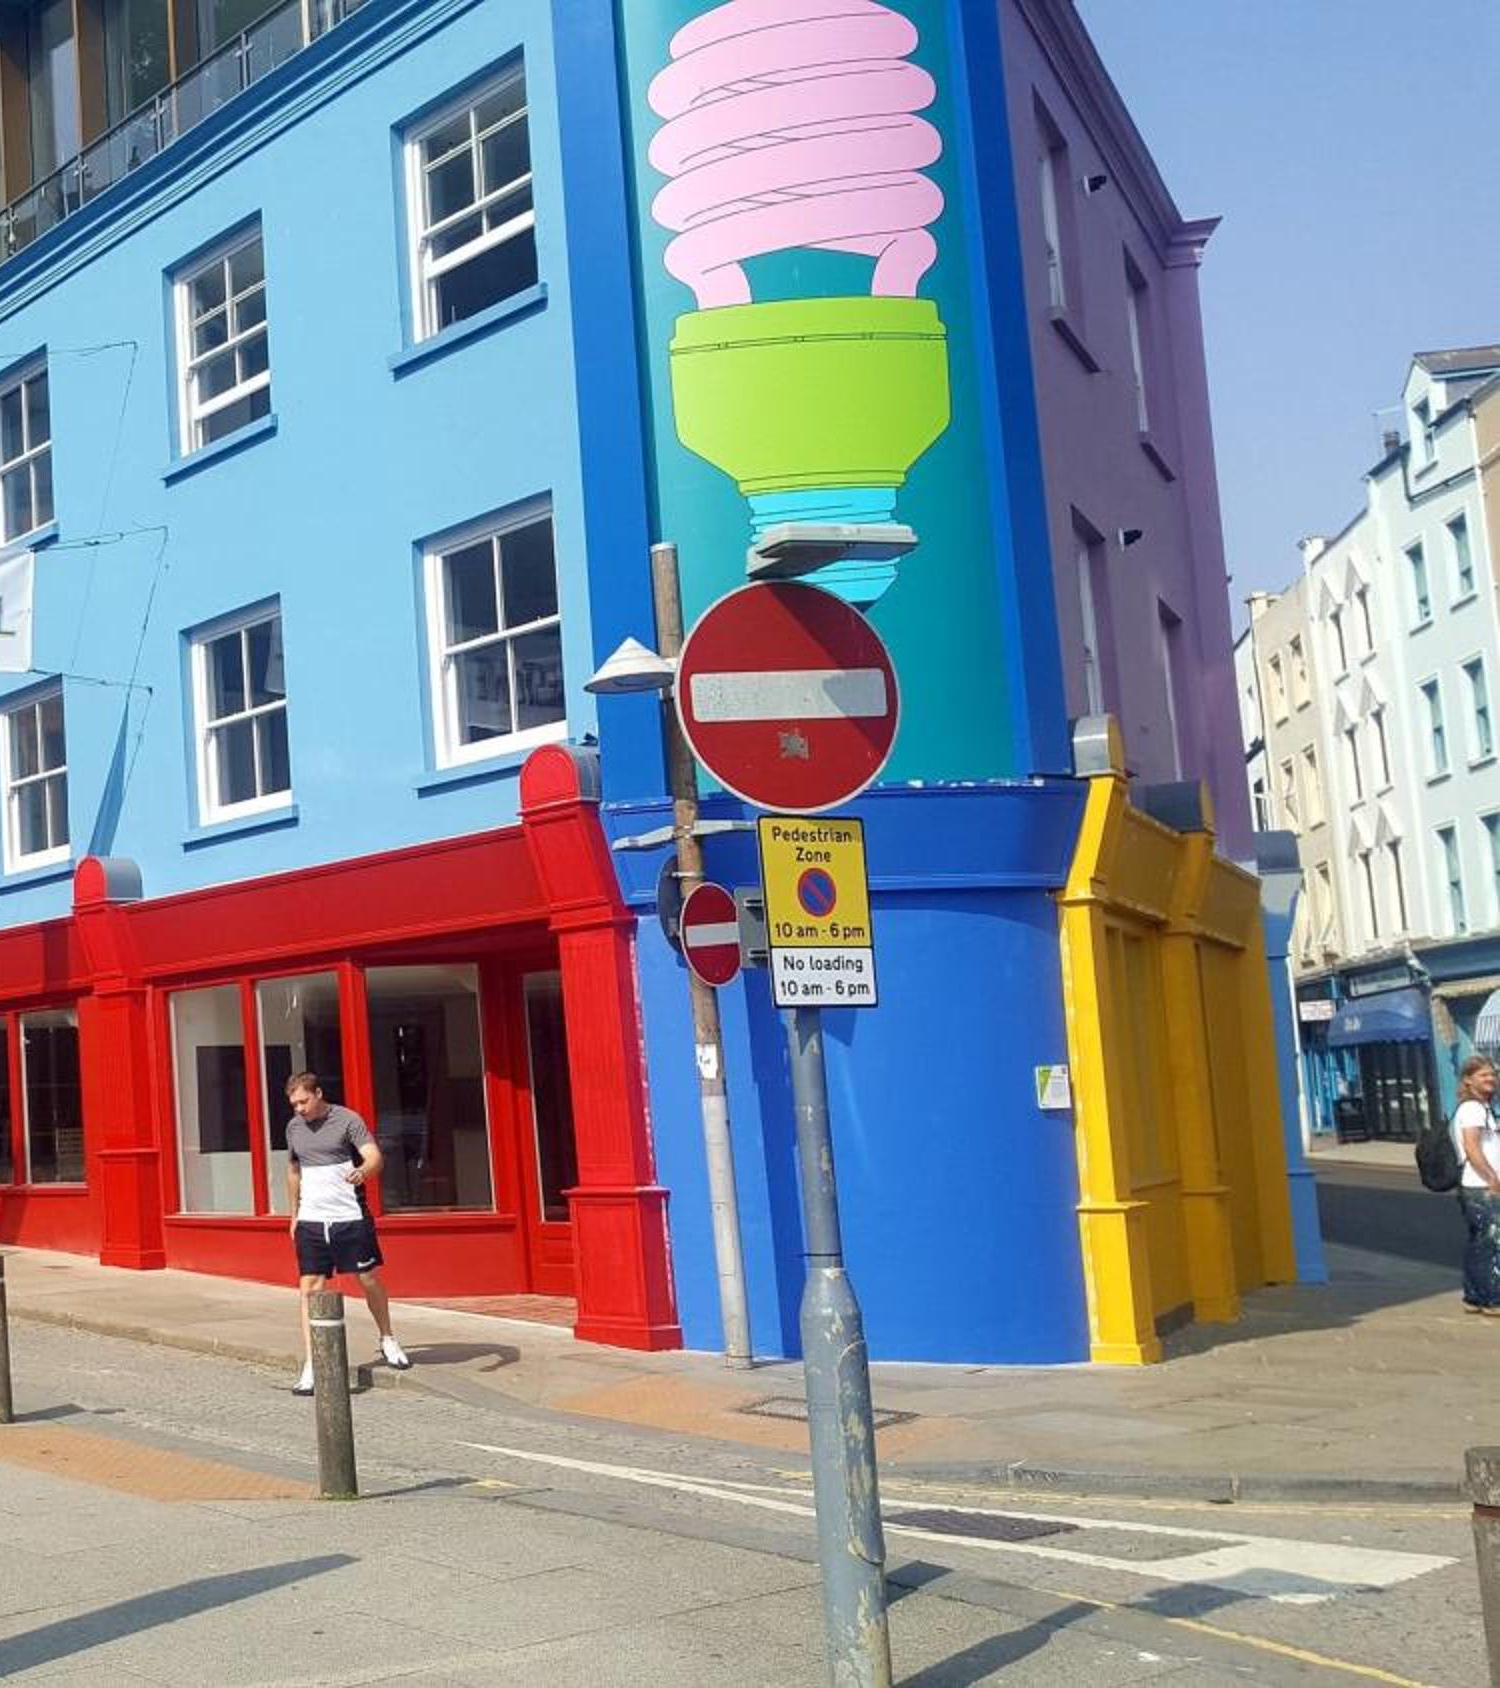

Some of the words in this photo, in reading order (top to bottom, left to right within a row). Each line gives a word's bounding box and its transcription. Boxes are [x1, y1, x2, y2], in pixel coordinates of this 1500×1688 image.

[772, 825, 852, 843] Pedestrian
[795, 847, 831, 862] Zone
[775, 922, 793, 938] 10
[796, 926, 818, 938] am
[830, 922, 839, 938] 6
[843, 926, 865, 940] pm
[783, 955, 805, 970] No
[810, 955, 863, 973] loading
[781, 980, 798, 996] 10
[801, 983, 822, 996] am
[835, 980, 845, 996] 6
[847, 983, 870, 998] pm
